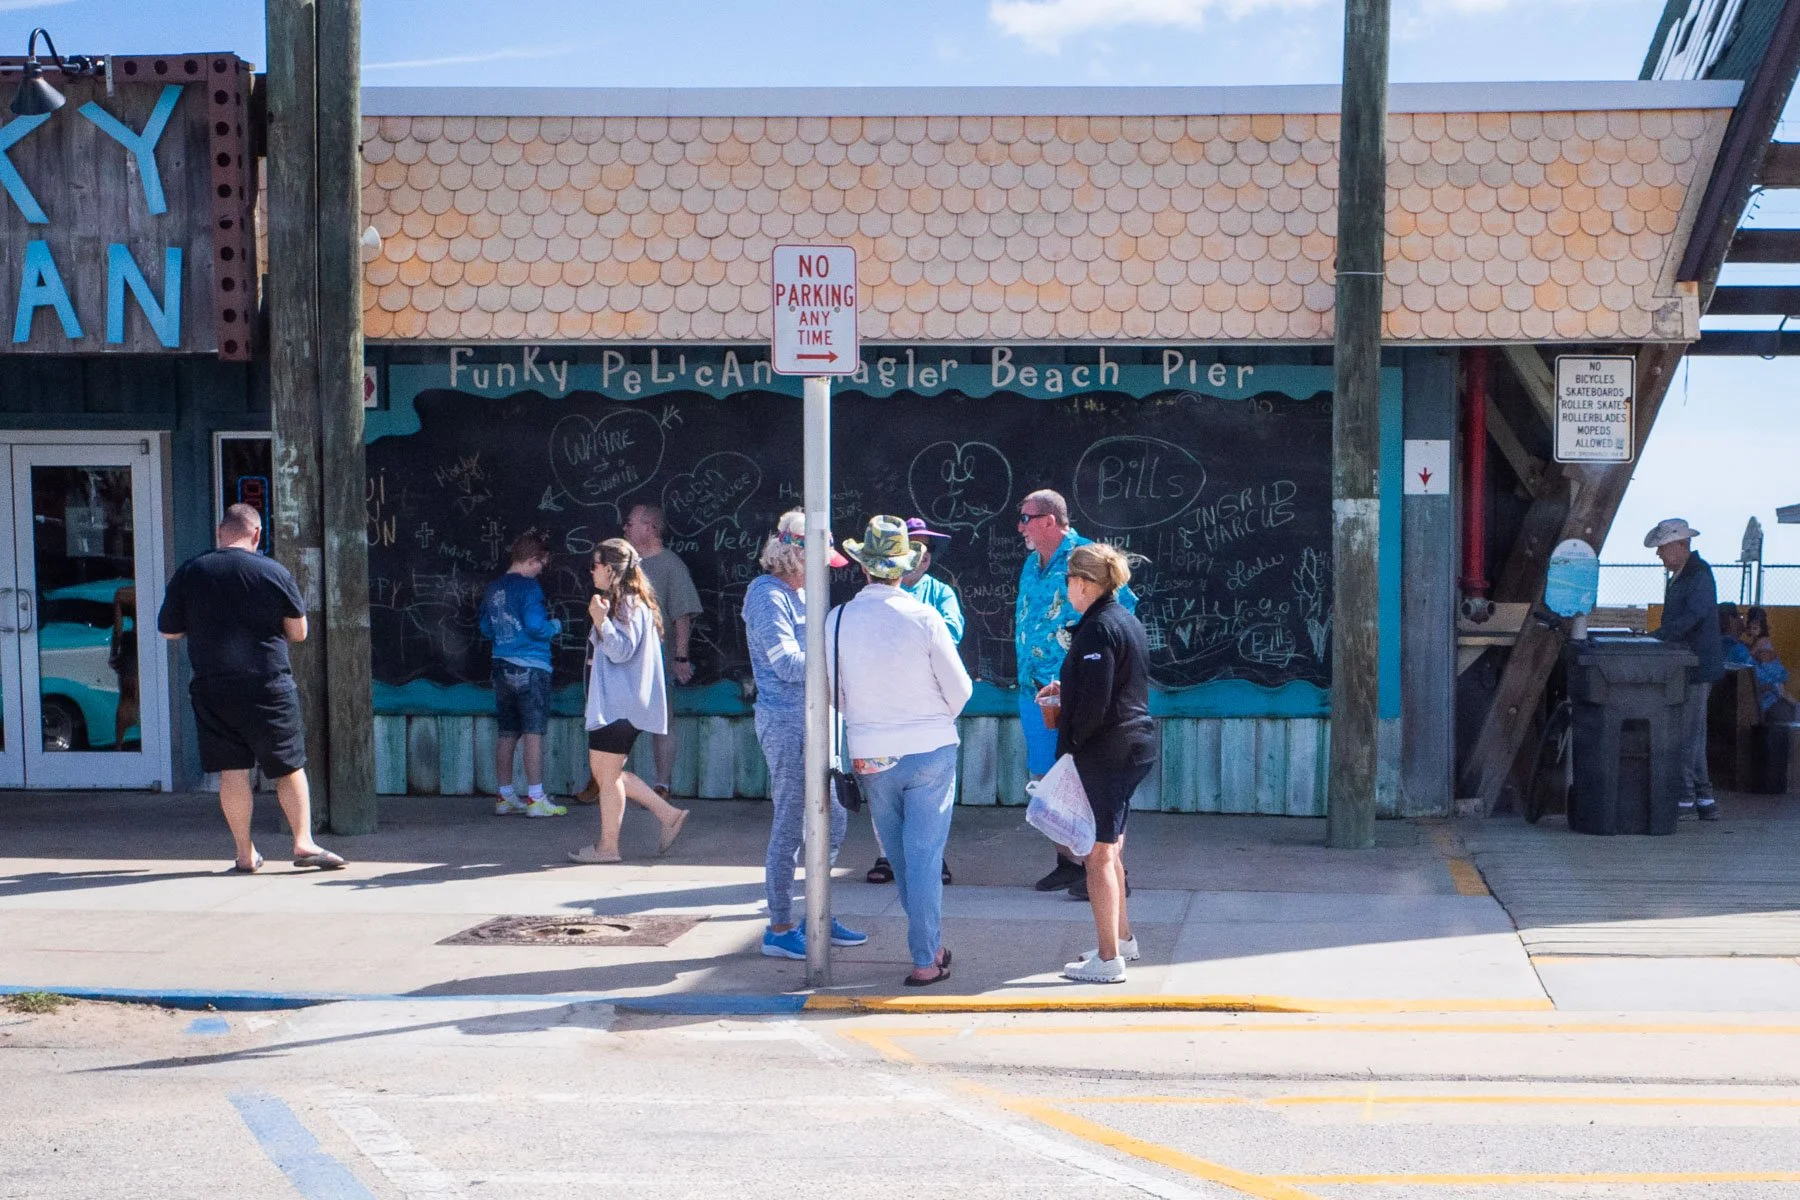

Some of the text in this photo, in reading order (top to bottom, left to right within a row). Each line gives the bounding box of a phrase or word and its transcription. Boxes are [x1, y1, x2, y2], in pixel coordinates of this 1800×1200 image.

[799, 255, 829, 278] NO
[12, 240, 182, 348] AN
[776, 284, 854, 307] PARKING
[799, 311, 830, 326] ANY
[797, 330, 833, 345] TIME
[837, 347, 958, 389] agler
[991, 346, 1120, 393] Beach
[1162, 349, 1254, 390] Pier
[1589, 361, 1601, 371] NO
[1575, 374, 1615, 384] BICYCLES
[1565, 387, 1625, 397] SKATEBOARDS
[1561, 400, 1627, 410] ROLLER SKATES
[1562, 413, 1627, 423] ROLLERBLADES
[1577, 426, 1611, 435] MOPEDS
[1575, 438, 1613, 448] ALLOWED
